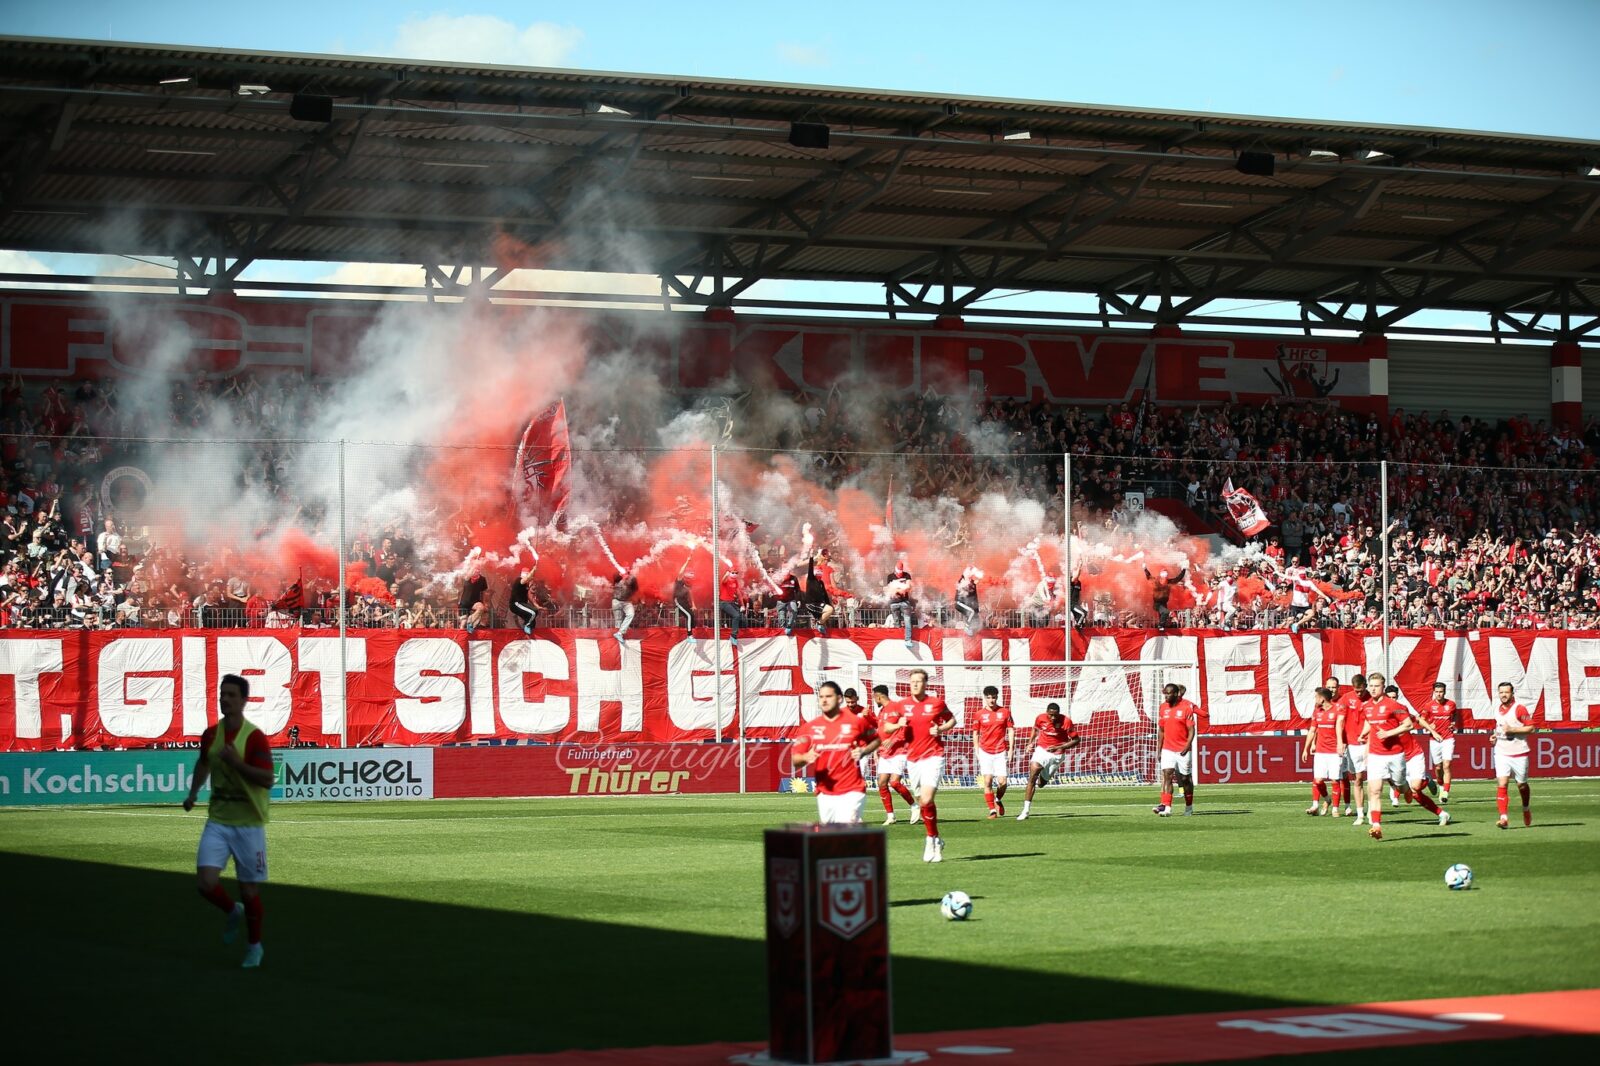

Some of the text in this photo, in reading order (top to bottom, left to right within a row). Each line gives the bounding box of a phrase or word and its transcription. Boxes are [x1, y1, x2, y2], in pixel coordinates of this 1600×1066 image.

[1289, 349, 1319, 360] HFC
[1128, 497, 1144, 510] 19a
[98, 636, 367, 738] GIBT
[395, 637, 643, 735] SICH
[567, 748, 633, 760] Fuhrbetrieb
[285, 785, 423, 799] DAS KOCHSTUDIO
[825, 862, 870, 880] HFC
